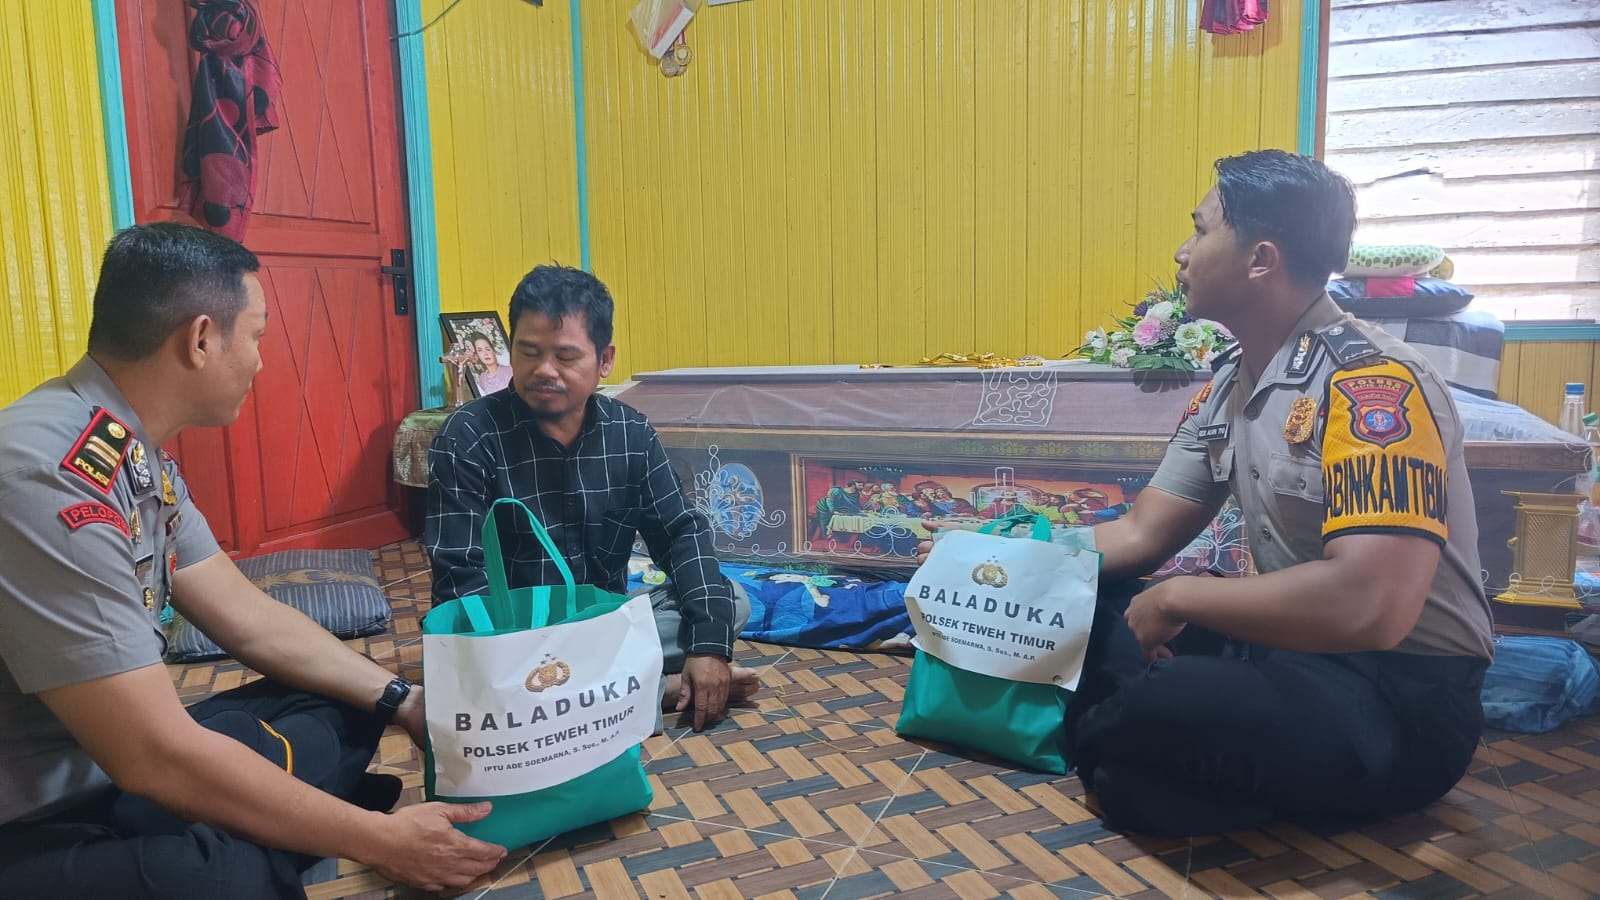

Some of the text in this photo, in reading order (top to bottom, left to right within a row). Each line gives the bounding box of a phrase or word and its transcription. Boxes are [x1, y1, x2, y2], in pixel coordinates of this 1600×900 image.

[919, 585, 1065, 629] BALADUKA
[920, 612, 1056, 651] POLSEK TEWEH TIMUR
[455, 675, 641, 732] BALADUKA
[463, 705, 635, 758] POLSEK TEWEH TIMUR
[484, 765, 504, 773] IPTU
[506, 762, 523, 770] ADE
